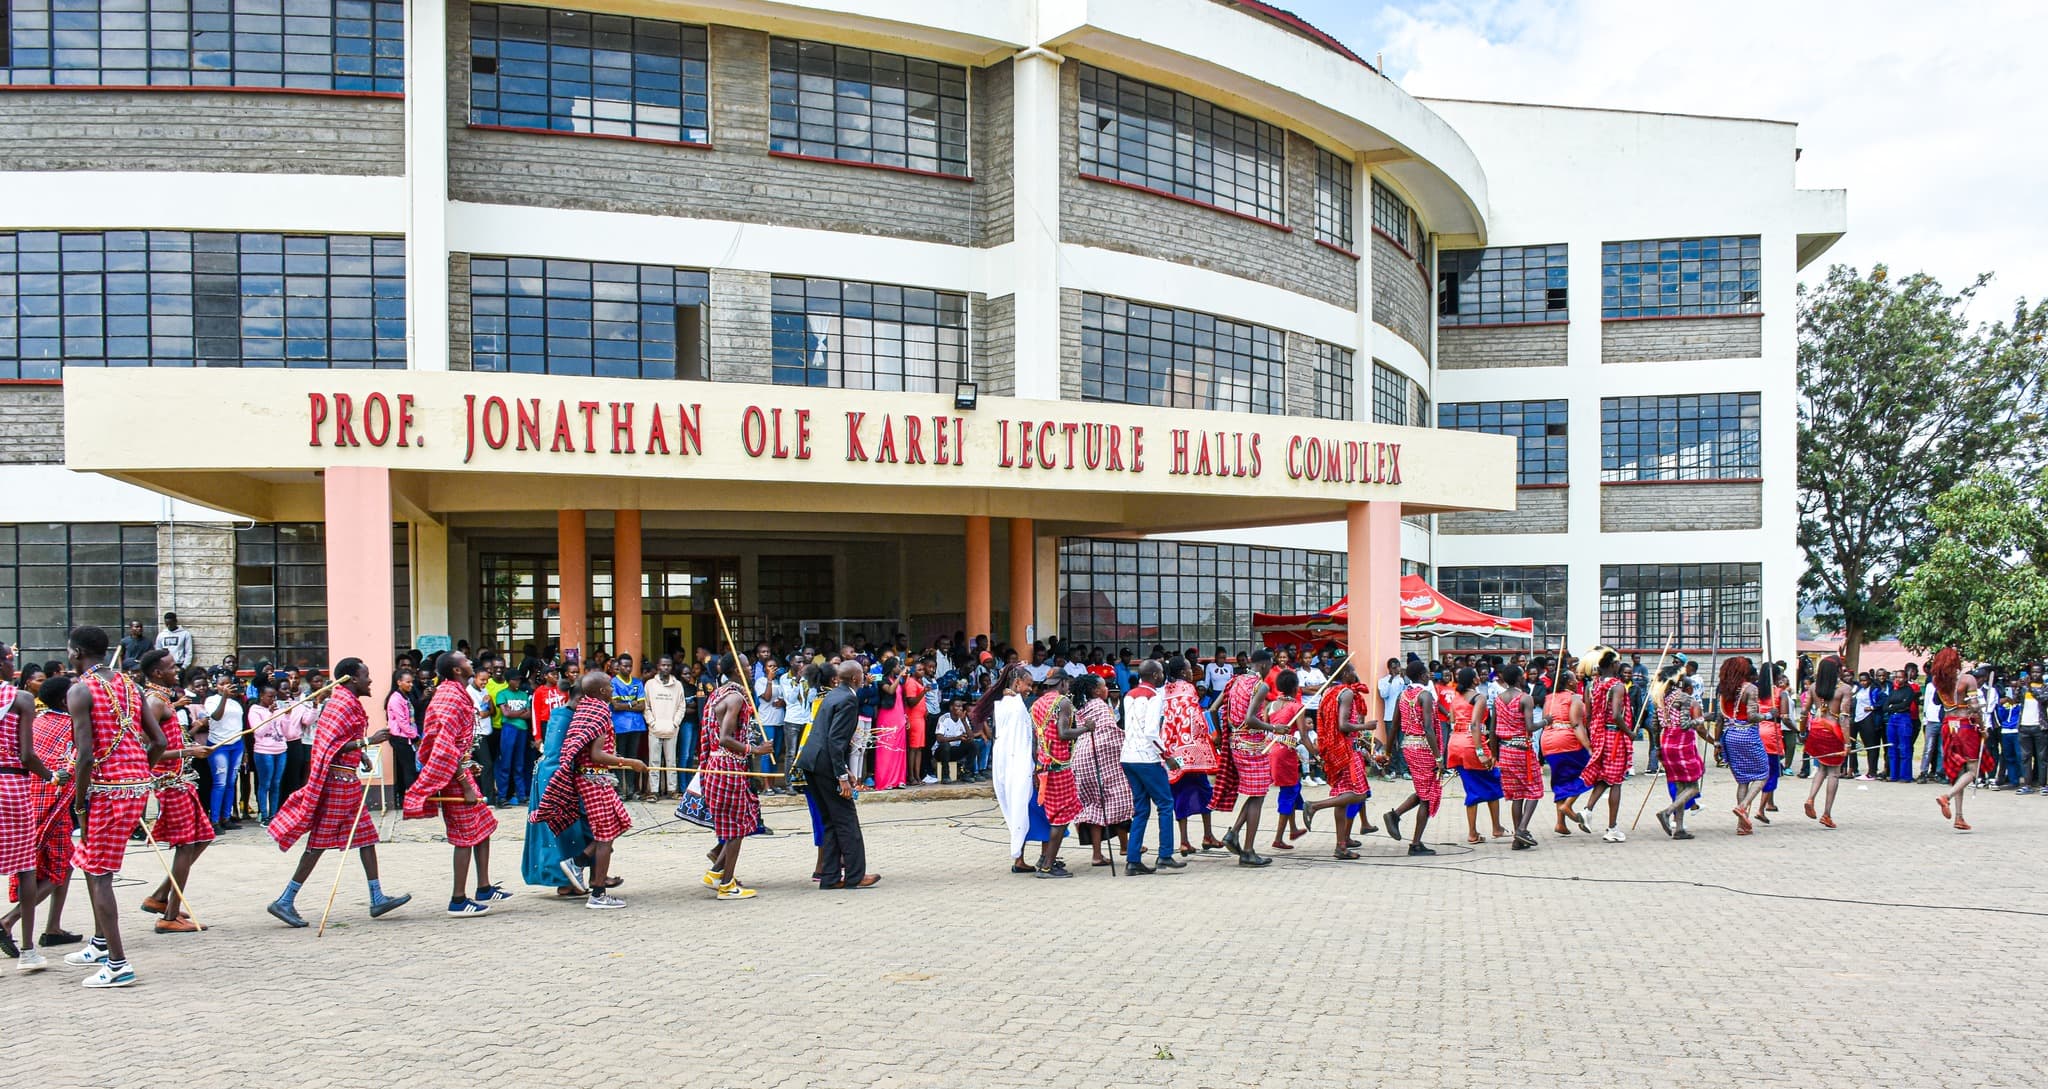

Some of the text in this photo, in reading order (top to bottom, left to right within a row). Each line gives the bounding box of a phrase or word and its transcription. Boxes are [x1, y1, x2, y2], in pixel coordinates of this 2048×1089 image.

[309, 392, 1402, 485] PROF. JONATHAN OLE KAREI LECTURE HALLS COMPLEX
